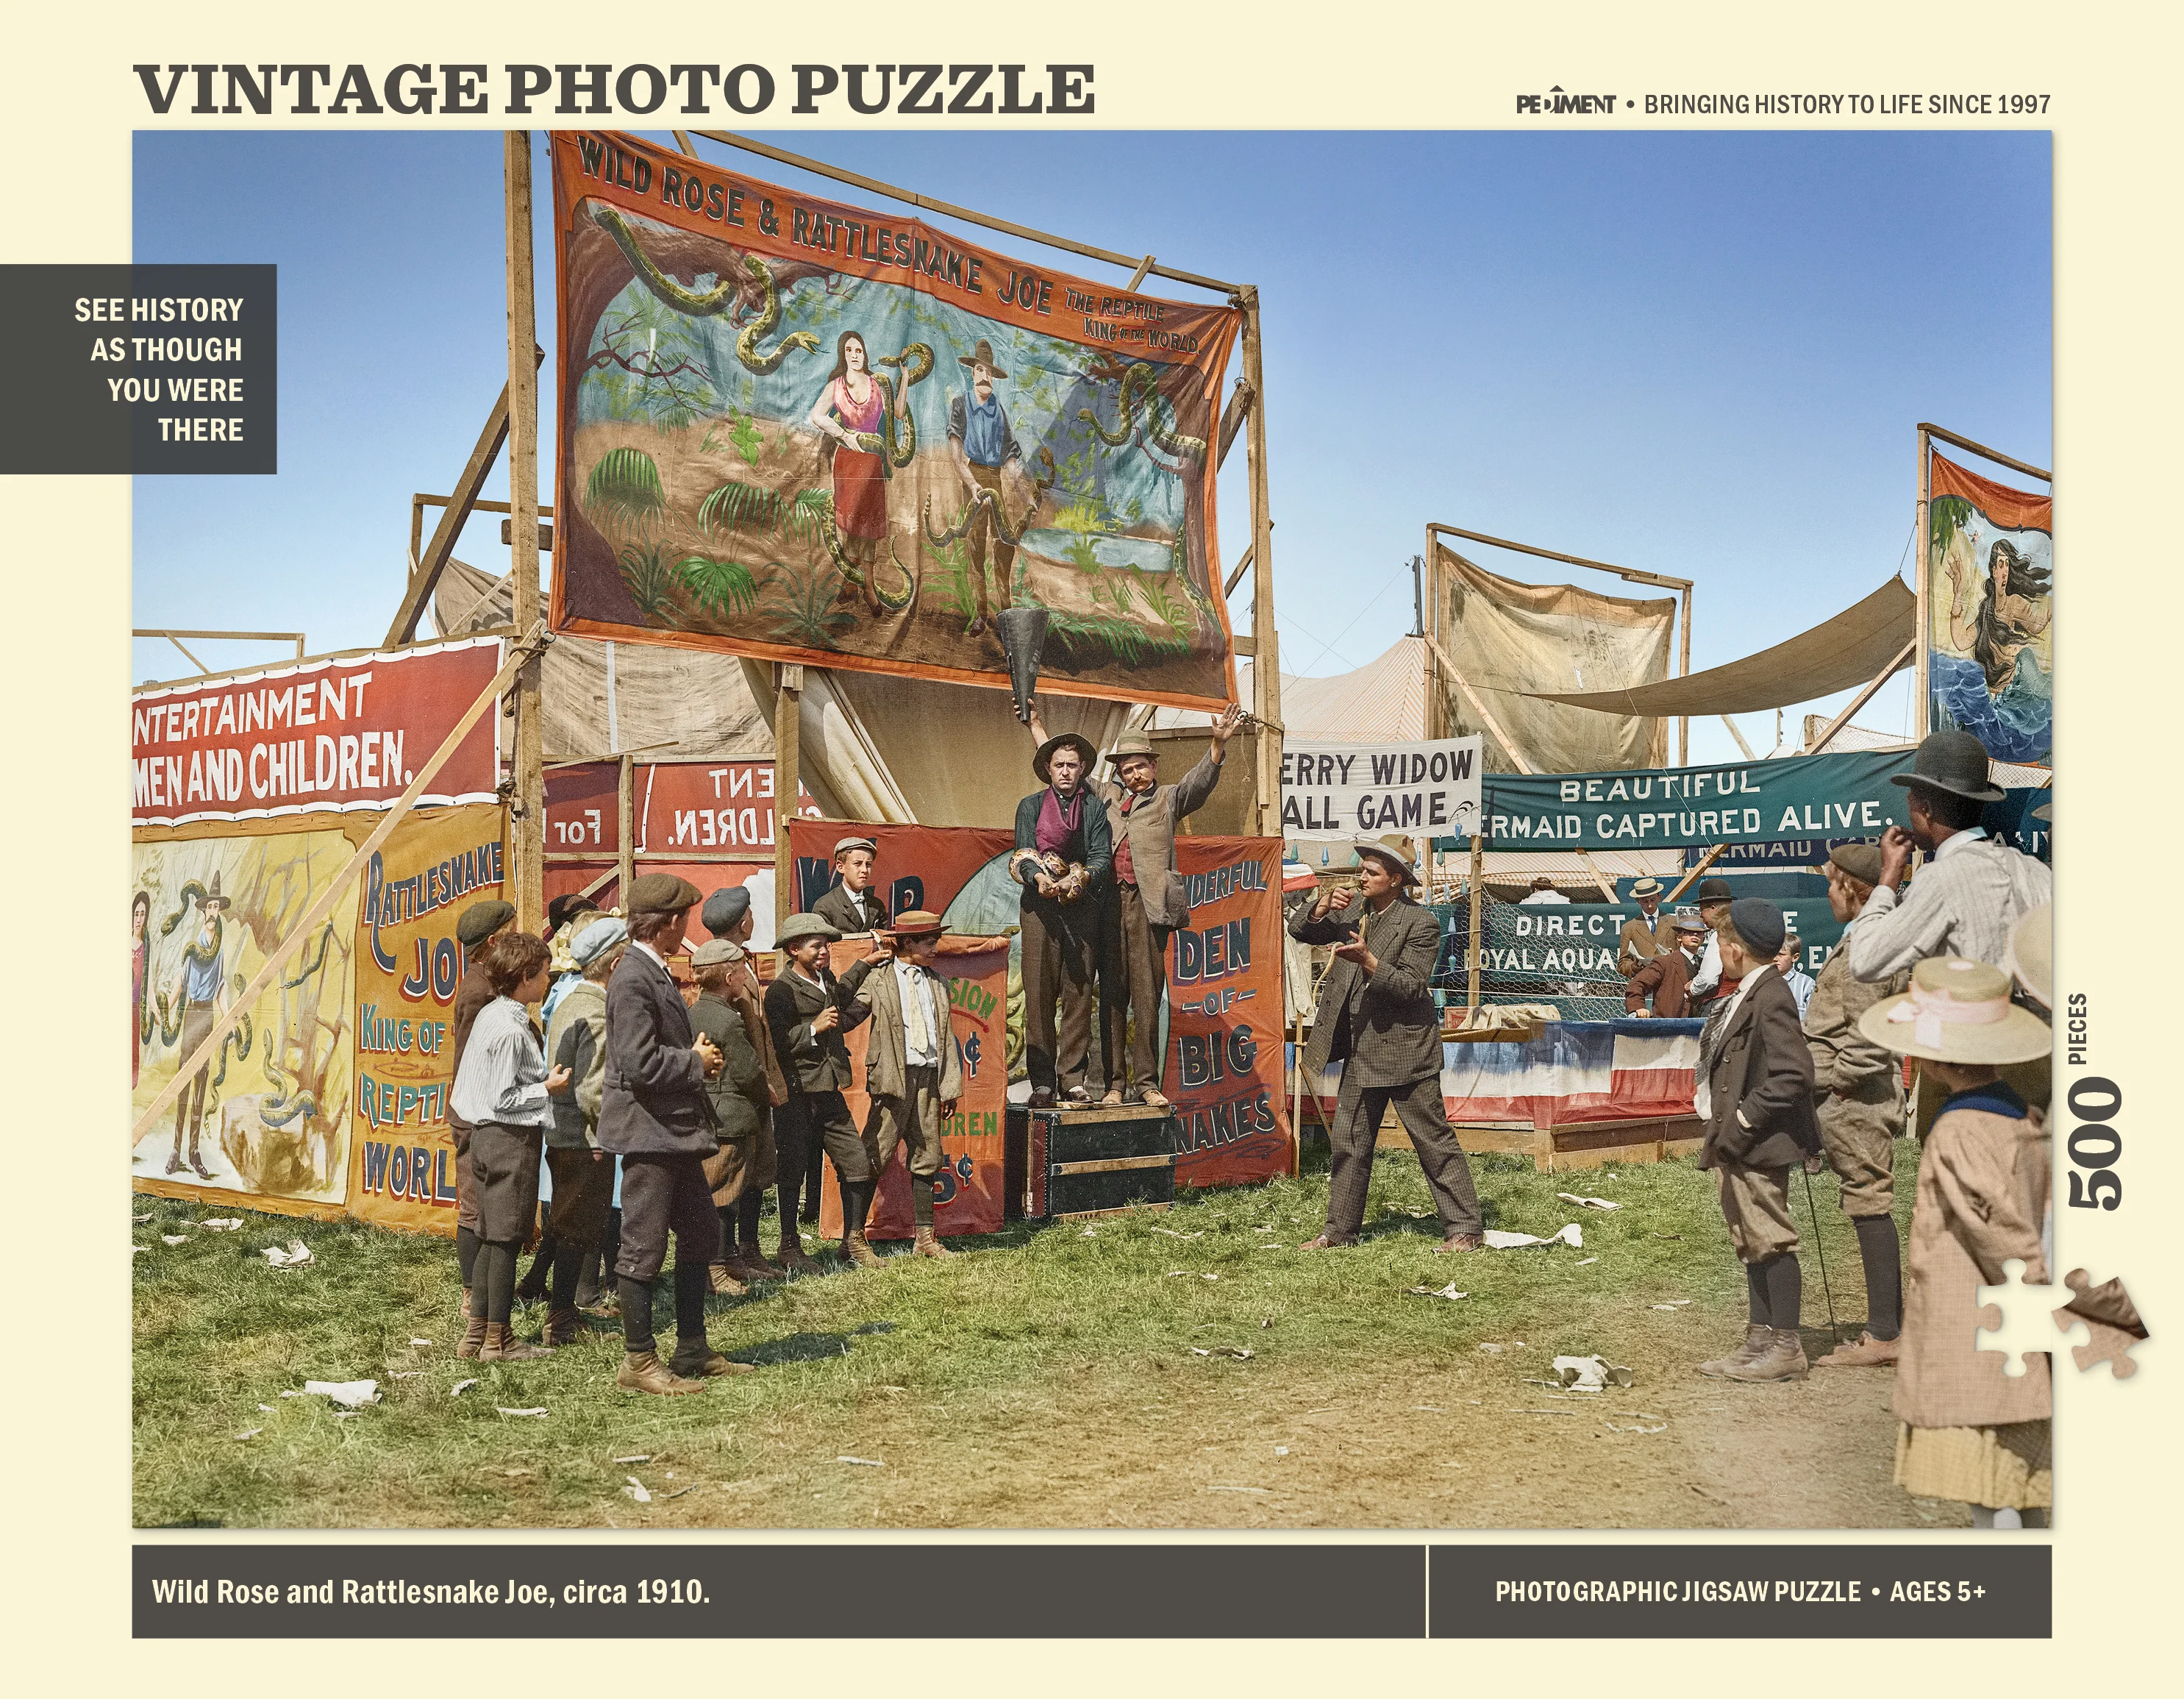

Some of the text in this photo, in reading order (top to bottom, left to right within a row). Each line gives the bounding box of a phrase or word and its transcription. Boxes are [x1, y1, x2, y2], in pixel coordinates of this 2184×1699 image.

[577, 135, 1054, 316] WILD ROSE & RATTLESNAKE JOE
[1065, 286, 1166, 324] THE REPTILE
[1083, 317, 1202, 357] KING OF THE WORLD.
[132, 671, 372, 746] NTERTAINMENT
[188, 748, 243, 802] AND
[249, 730, 413, 799] CHILDREN.
[1371, 749, 1473, 785] WIDOW
[1560, 770, 1760, 802] BEAUTIFUL
[1282, 791, 1447, 830] ALL GAME
[1596, 808, 1760, 838] CAPTURED
[1777, 801, 1894, 832] ALIVE.
[362, 841, 506, 975] RATTLESNAKE
[1516, 914, 1626, 936] DIRECT
[401, 937, 469, 1002] JO
[1174, 917, 1251, 983] DEN
[1542, 948, 1620, 973] AQUA
[360, 1002, 446, 1054] KING OF
[1178, 1024, 1257, 1089] BIG
[359, 1072, 454, 1129] REPTI
[364, 1141, 461, 1204] WORL
